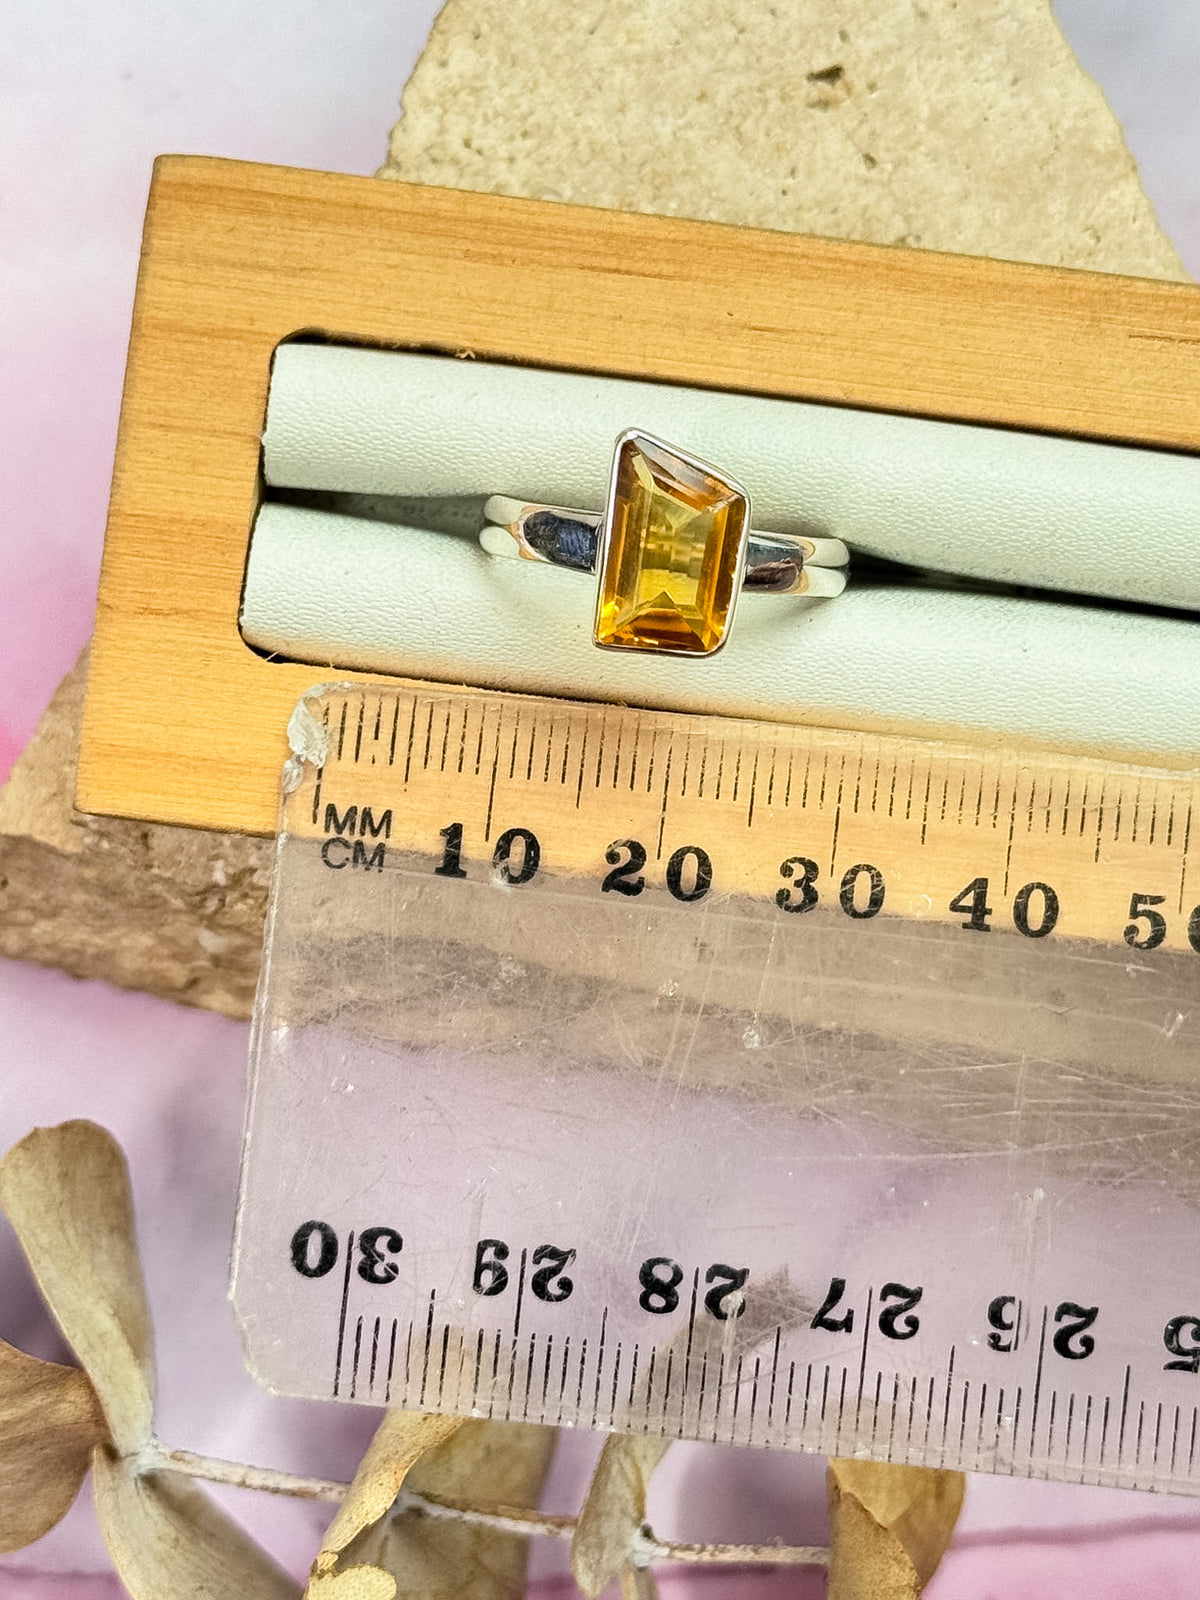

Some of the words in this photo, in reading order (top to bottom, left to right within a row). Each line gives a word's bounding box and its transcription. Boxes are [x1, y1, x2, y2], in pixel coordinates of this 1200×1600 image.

[324, 803, 393, 840] MM
[321, 837, 386, 873] CM
[434, 821, 541, 885] 10
[601, 838, 714, 902] 20
[775, 856, 886, 919] 30
[949, 877, 1060, 939] 40
[1123, 892, 1200, 956] 5
[290, 1219, 403, 1285] 30
[472, 1238, 577, 1303] 29
[638, 1256, 751, 1321] 28
[809, 1277, 923, 1340] 27
